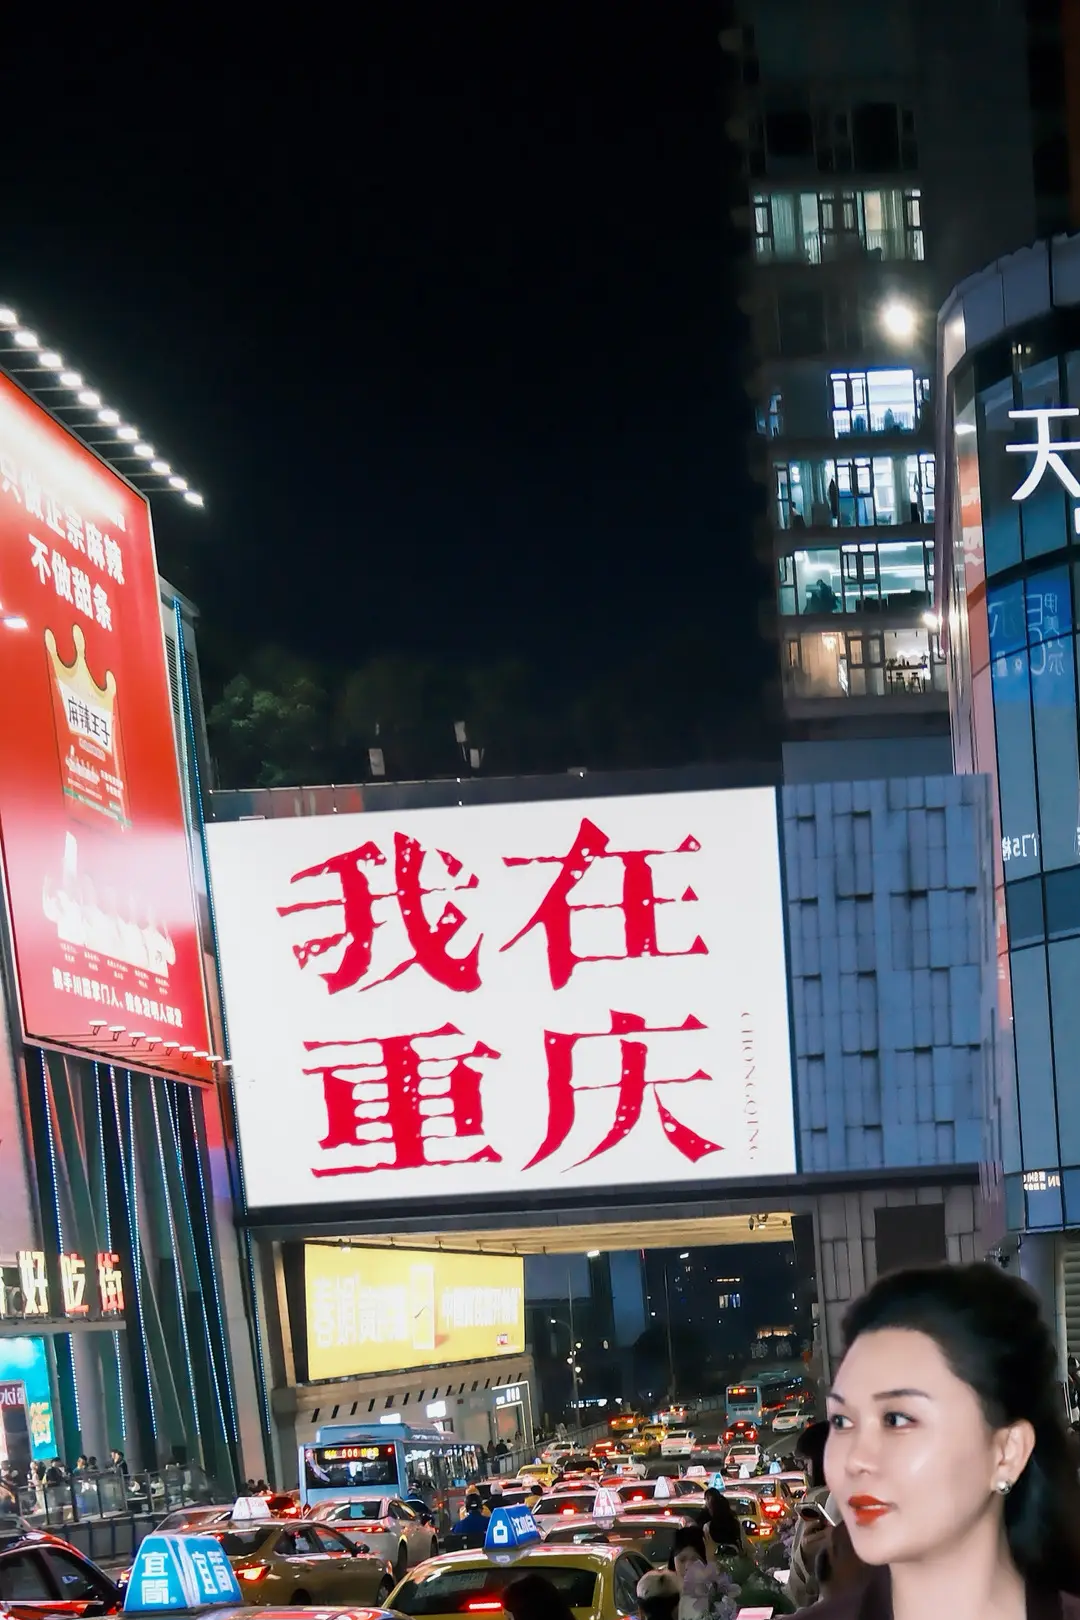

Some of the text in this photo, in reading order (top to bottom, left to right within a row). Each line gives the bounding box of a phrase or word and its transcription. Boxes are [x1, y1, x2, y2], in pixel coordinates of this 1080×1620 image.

[68, 697, 110, 746] 麻辣王子
[276, 817, 709, 994] 我在
[301, 1009, 725, 1178] 重庆
[0, 1250, 125, 1314] 好吃街
